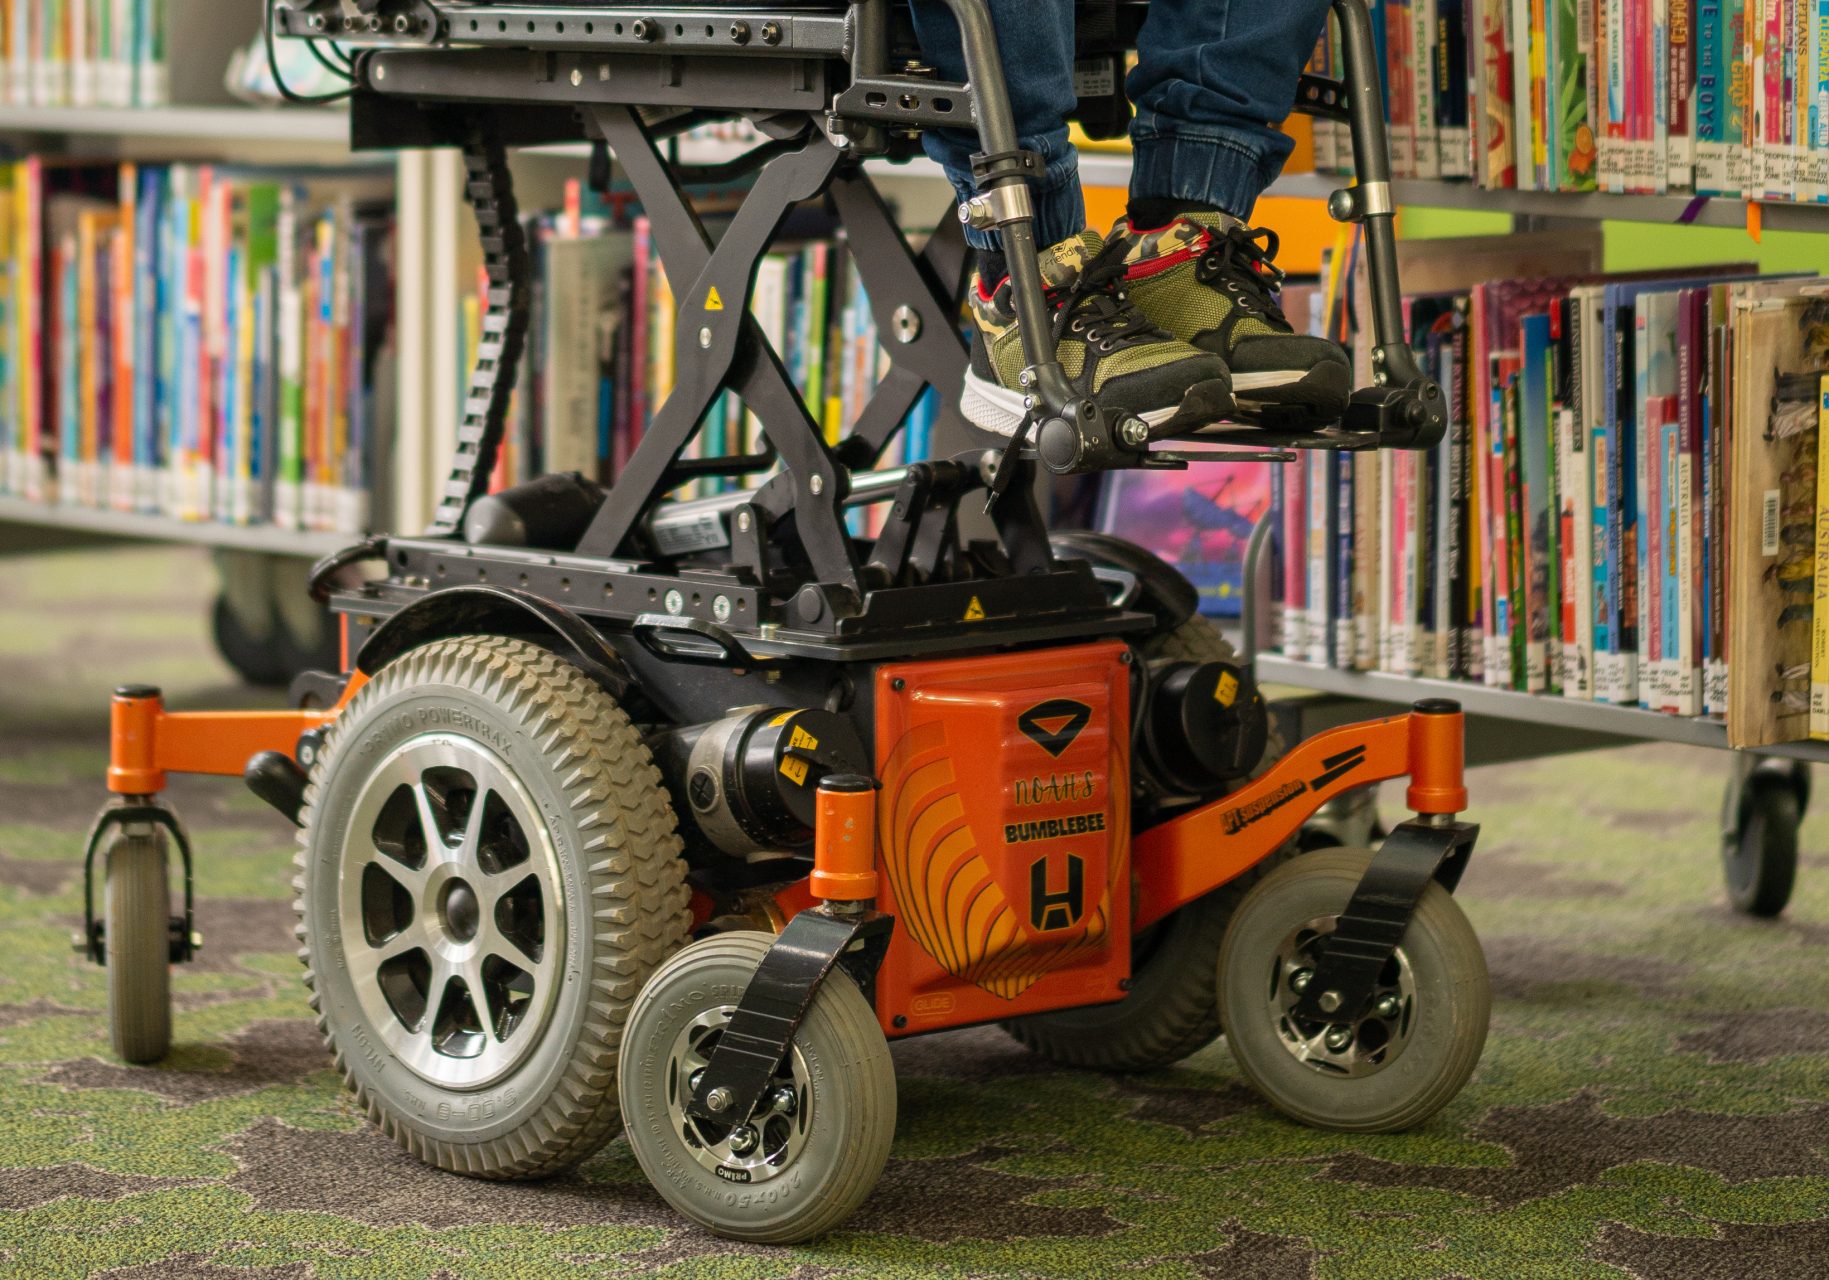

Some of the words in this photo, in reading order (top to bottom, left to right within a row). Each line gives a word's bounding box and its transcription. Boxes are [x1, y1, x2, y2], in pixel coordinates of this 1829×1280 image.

[1415, 19, 1428, 78] PEOPLE
[1819, 15, 1829, 83] CLEOPATRA
[1699, 74, 1715, 137] BOYS
[1731, 112, 1743, 128] 2
[1452, 333, 1464, 361] THE
[1451, 364, 1464, 422] ROMANS
[1450, 425, 1462, 441] IN
[1680, 405, 1688, 448] HISTORY
[1449, 445, 1462, 500] BRITAIN
[1608, 451, 1616, 490] AZTECS
[1680, 461, 1689, 527] AUSTRALIA
[1816, 506, 1829, 600] AUSTRALIA
[417, 706, 513, 757] POWERTRAX
[1014, 771, 1096, 806] NOAH'S
[1004, 812, 1106, 844] BUMBLEBEE
[915, 997, 950, 1011] GLIDE
[351, 1023, 386, 1073] NYLON
[717, 1167, 748, 1181] PRIMO
